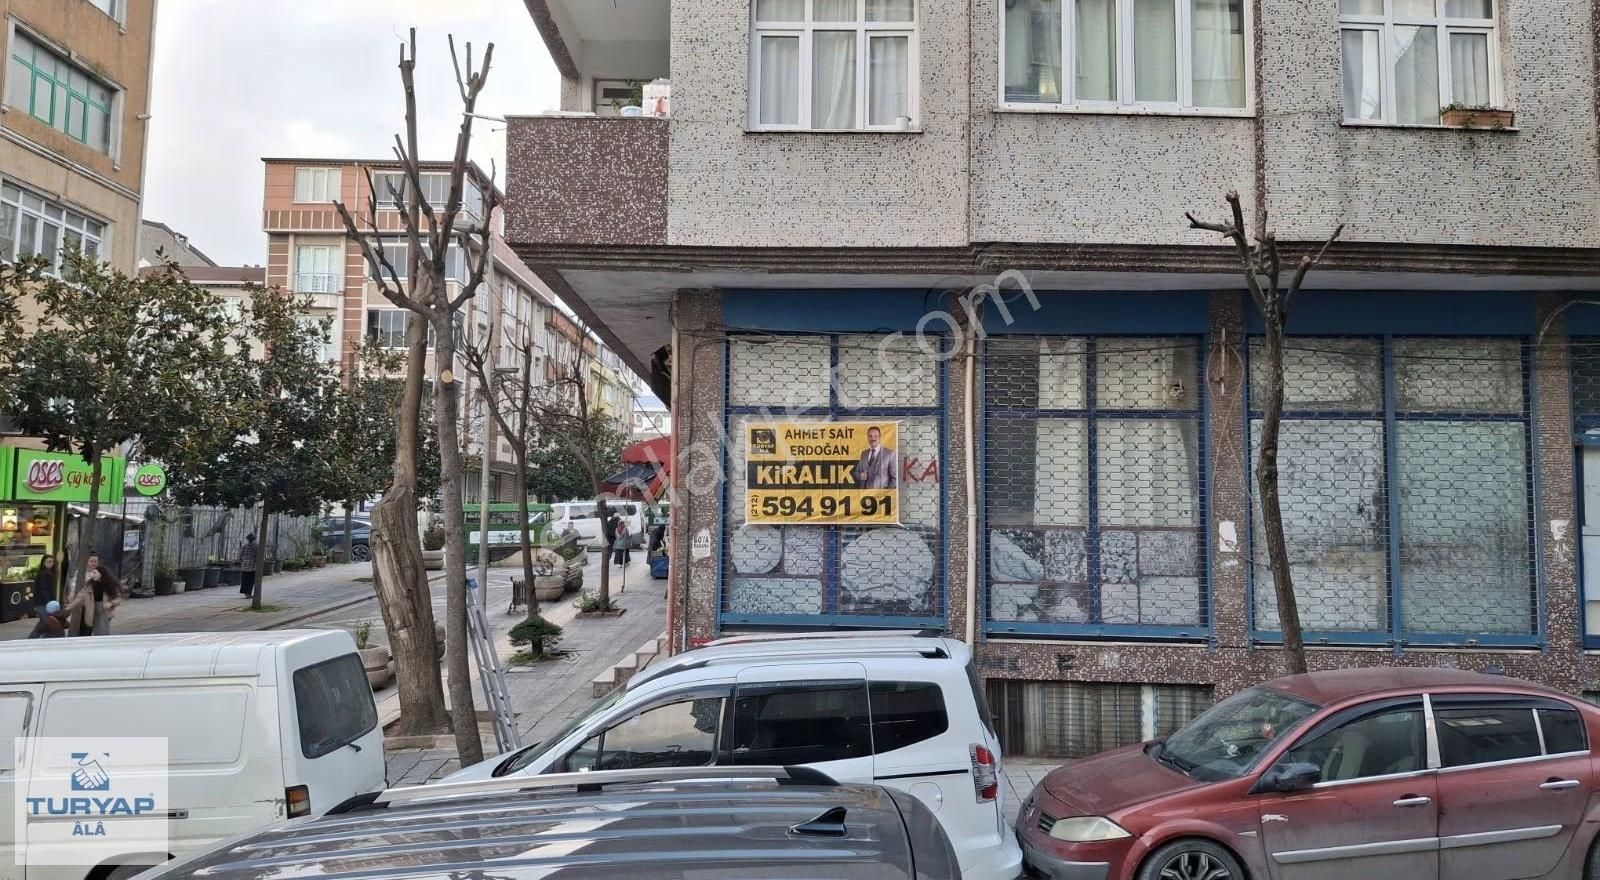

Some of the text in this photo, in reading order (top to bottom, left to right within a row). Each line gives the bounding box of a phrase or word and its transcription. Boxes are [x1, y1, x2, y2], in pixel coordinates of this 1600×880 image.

[785, 426, 855, 440] AHMET SAİT
[790, 443, 850, 456] ERDOĞAN
[903, 456, 938, 483] KA
[751, 494, 893, 517] (212) 594 91 91
